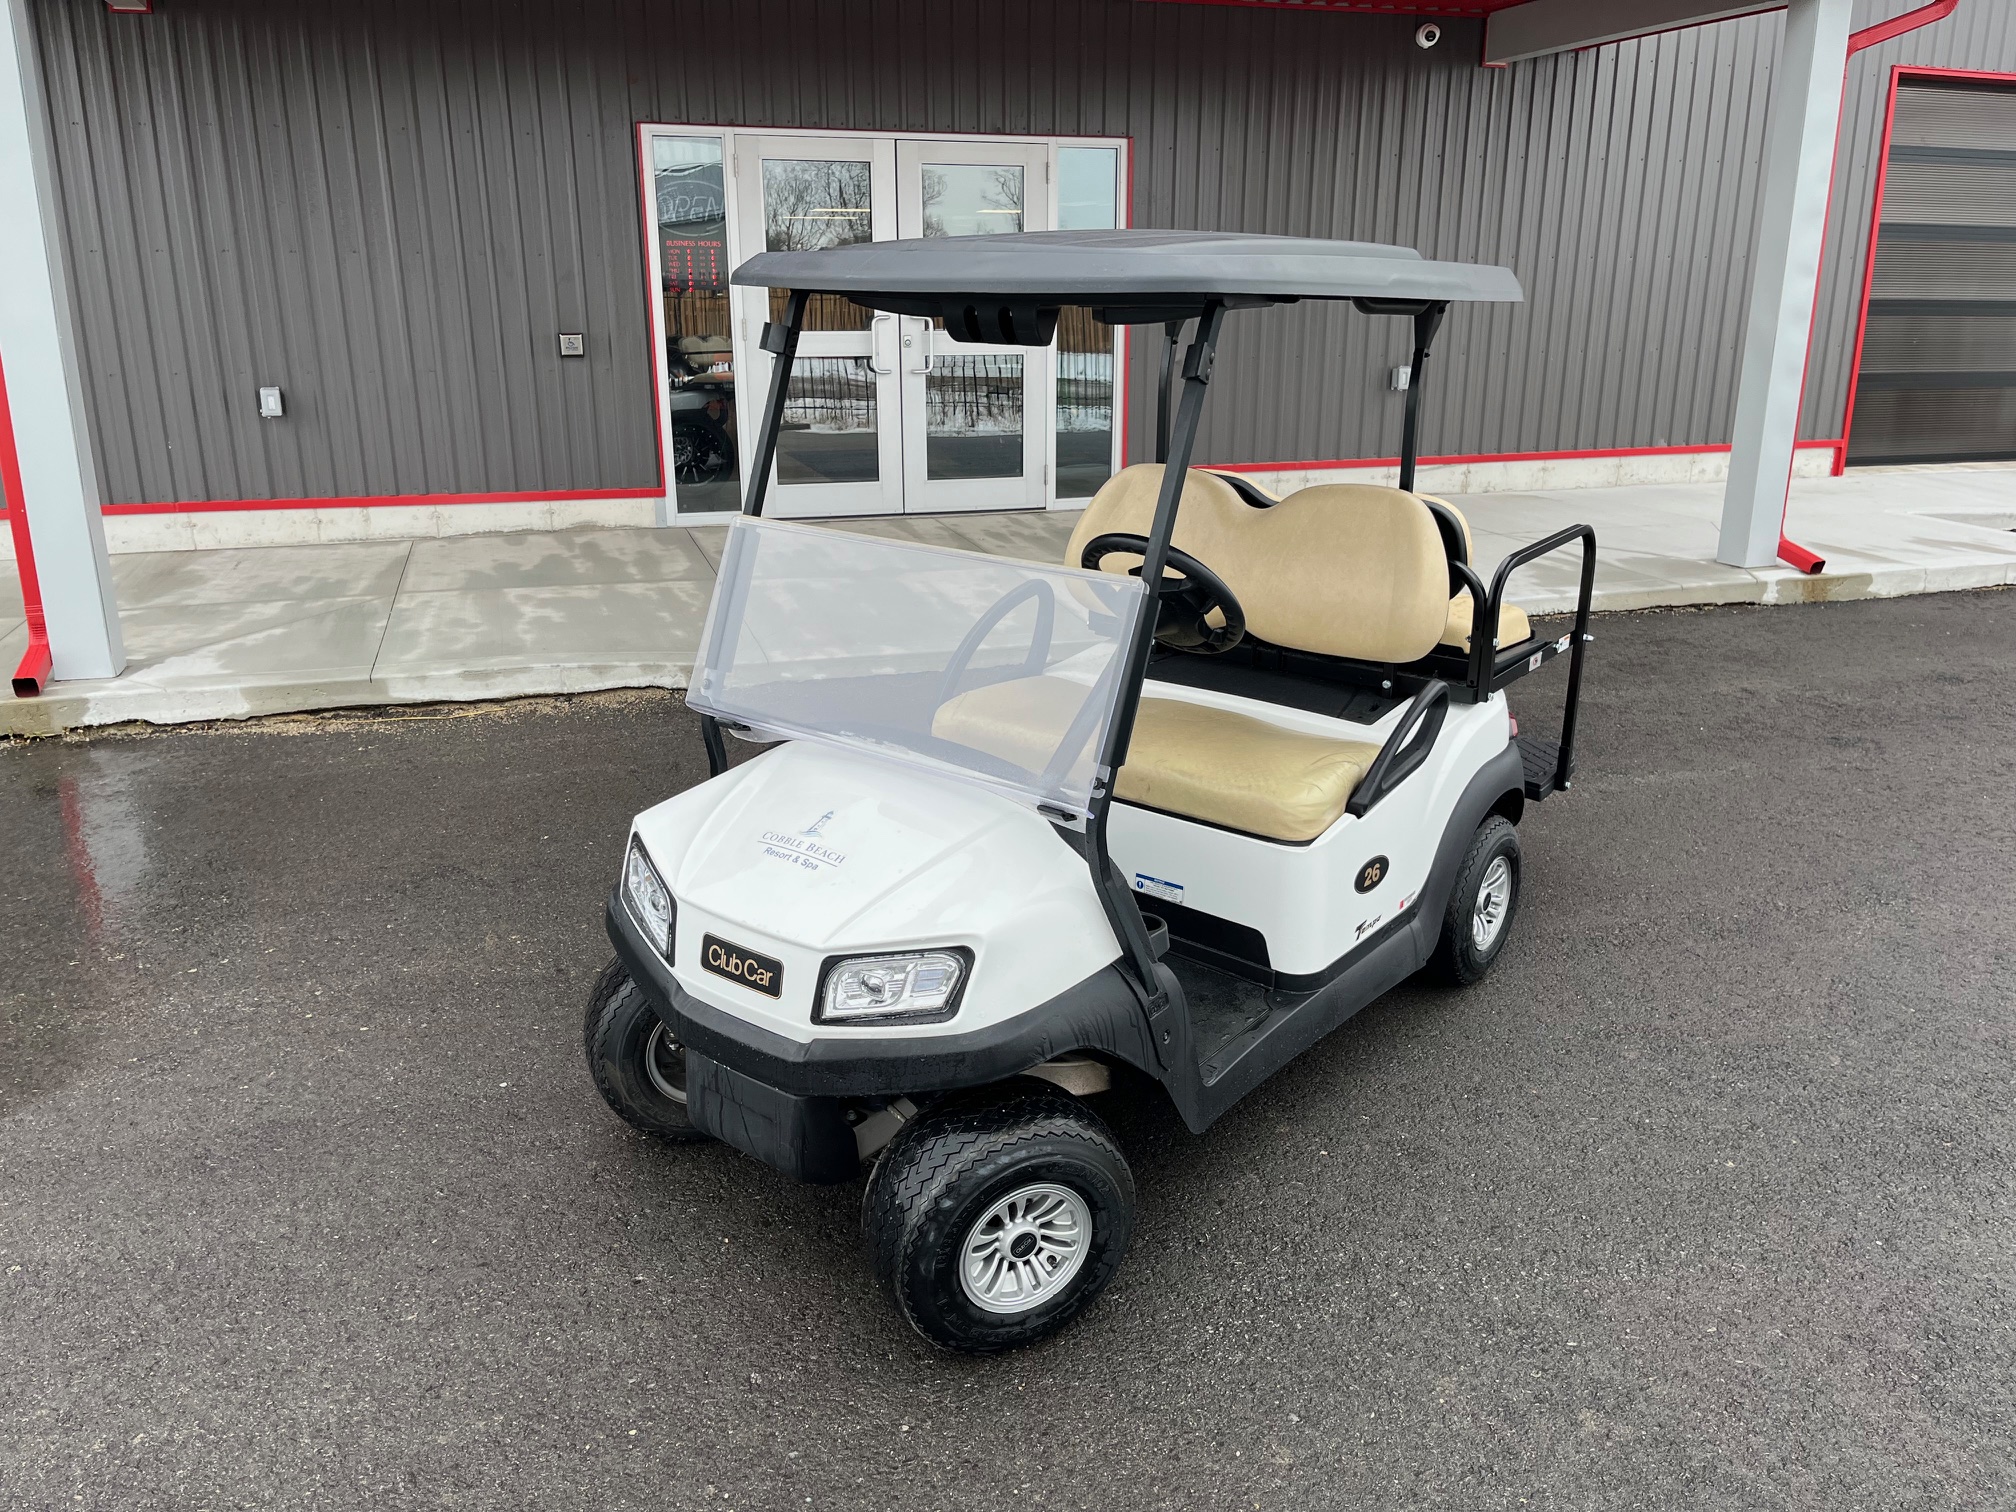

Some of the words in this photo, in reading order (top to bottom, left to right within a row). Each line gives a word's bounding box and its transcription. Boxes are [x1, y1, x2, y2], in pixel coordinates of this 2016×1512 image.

[657, 195, 725, 222] OPEN
[762, 831, 805, 849] COBBLE
[805, 842, 847, 864] BEACH
[763, 846, 793, 862] Resort
[792, 855, 801, 864] &
[800, 858, 819, 871] Spa
[1363, 863, 1381, 888] 26
[708, 944, 743, 975] Club
[743, 958, 774, 987] Car
